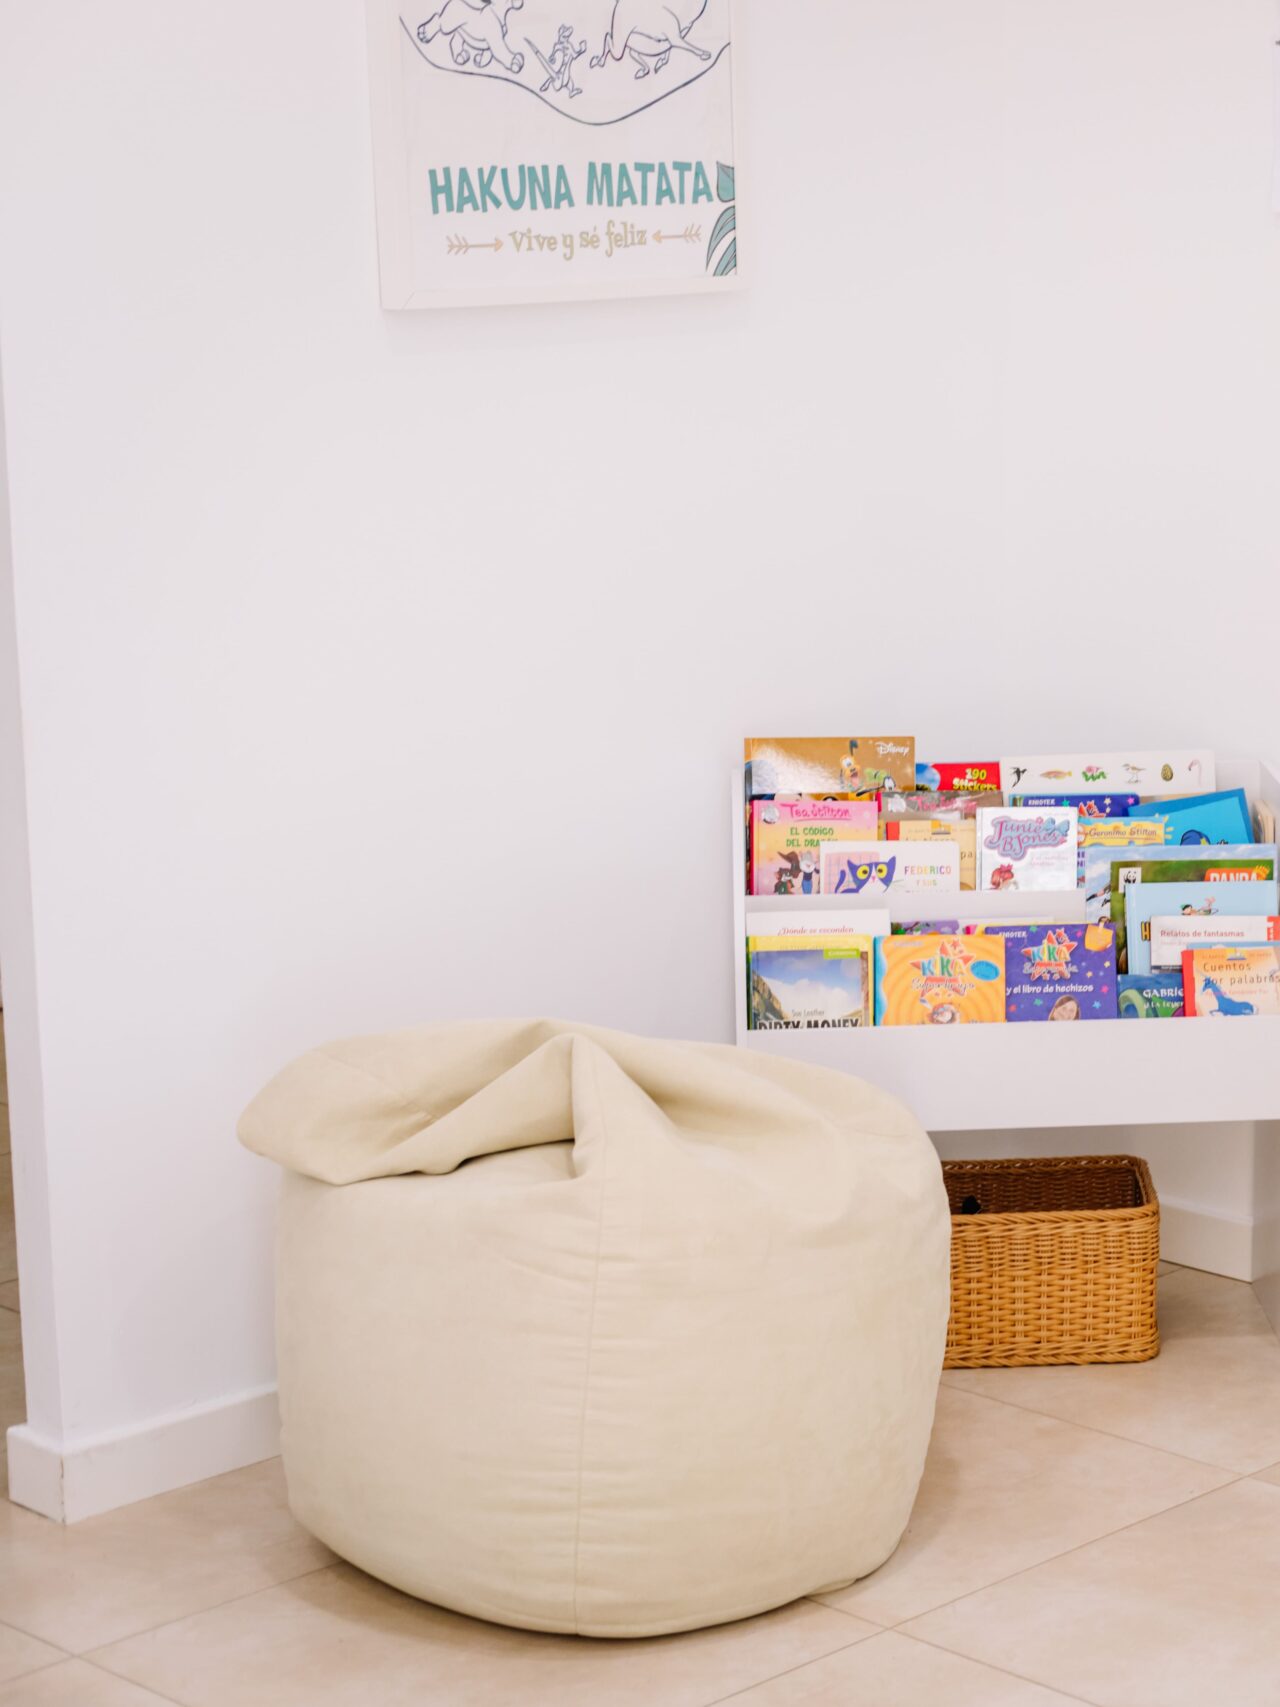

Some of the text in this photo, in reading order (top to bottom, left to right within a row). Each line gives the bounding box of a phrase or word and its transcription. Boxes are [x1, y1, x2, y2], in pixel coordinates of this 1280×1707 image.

[428, 160, 714, 215] HAKUNA MATATA
[508, 219, 647, 260] Vive y sé feliz
[952, 777, 997, 791] Stickers
[790, 827, 800, 836] EL
[1087, 825, 1157, 837] Geronimo Stilton
[786, 838, 801, 847] DEL
[904, 865, 952, 875] FEDERICO
[1160, 928, 1244, 938] Relatos de fantasmas
[1031, 942, 1071, 963] KIKA
[921, 956, 967, 977] KIKA
[1203, 963, 1252, 972] Cuentos
[1006, 983, 1094, 996] y el libro de hechizos
